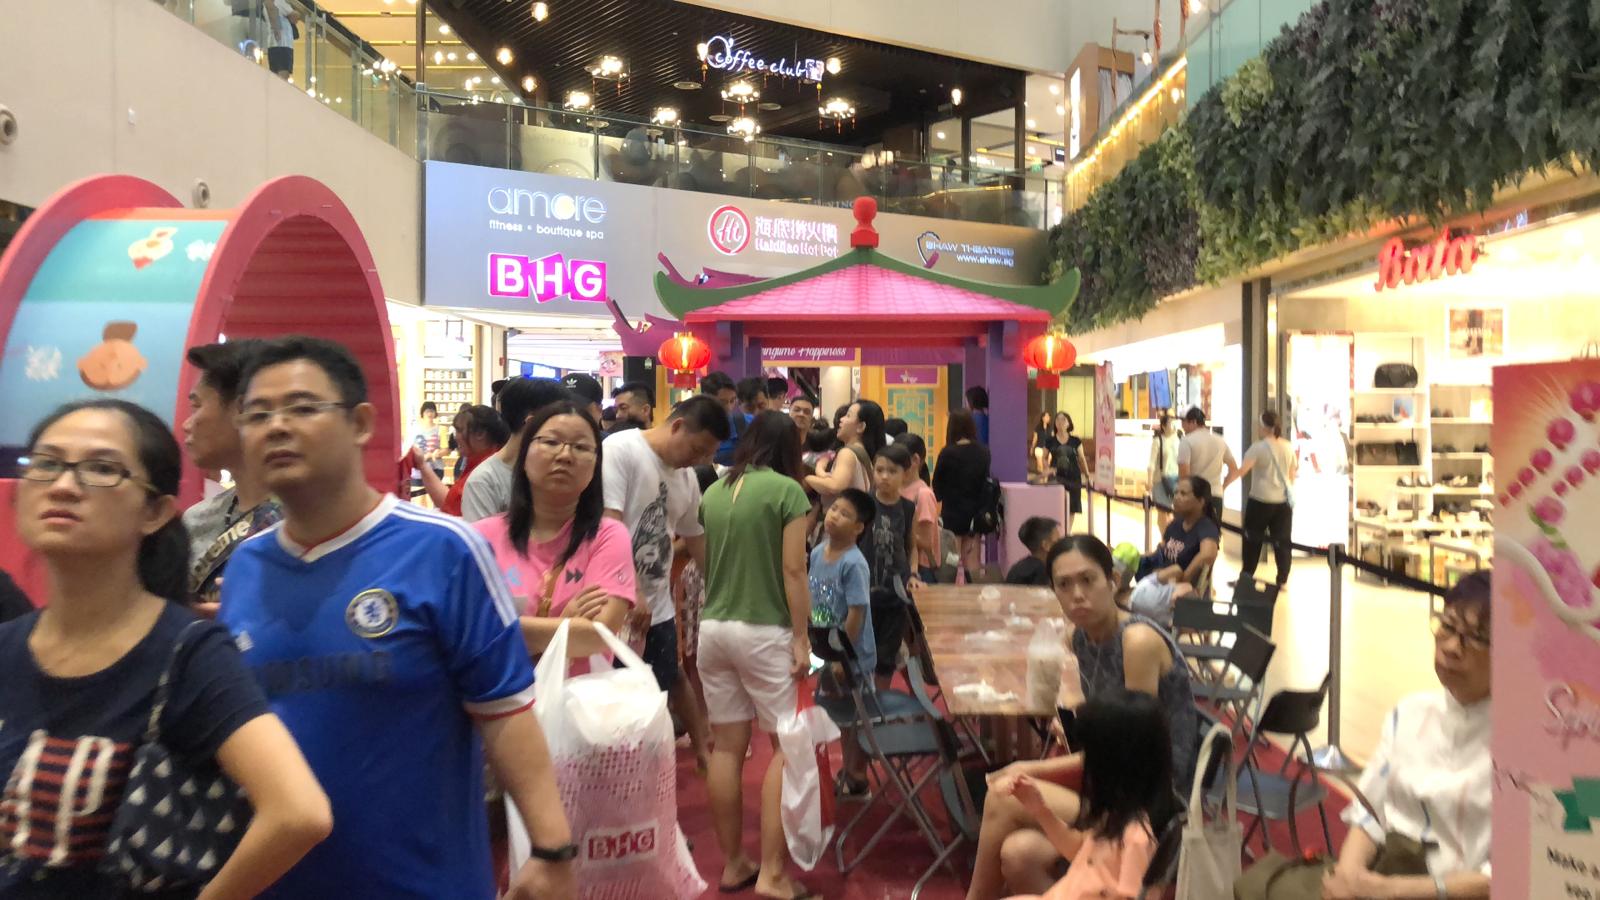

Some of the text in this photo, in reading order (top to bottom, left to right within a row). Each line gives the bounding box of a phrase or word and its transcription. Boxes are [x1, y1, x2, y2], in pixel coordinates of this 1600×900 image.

[769, 58, 805, 77] club
[488, 186, 606, 223] amore
[489, 219, 604, 240] fitness boutique spa
[1375, 226, 1478, 292] Bata
[493, 255, 605, 300] BHG
[590, 829, 655, 857] BHG
